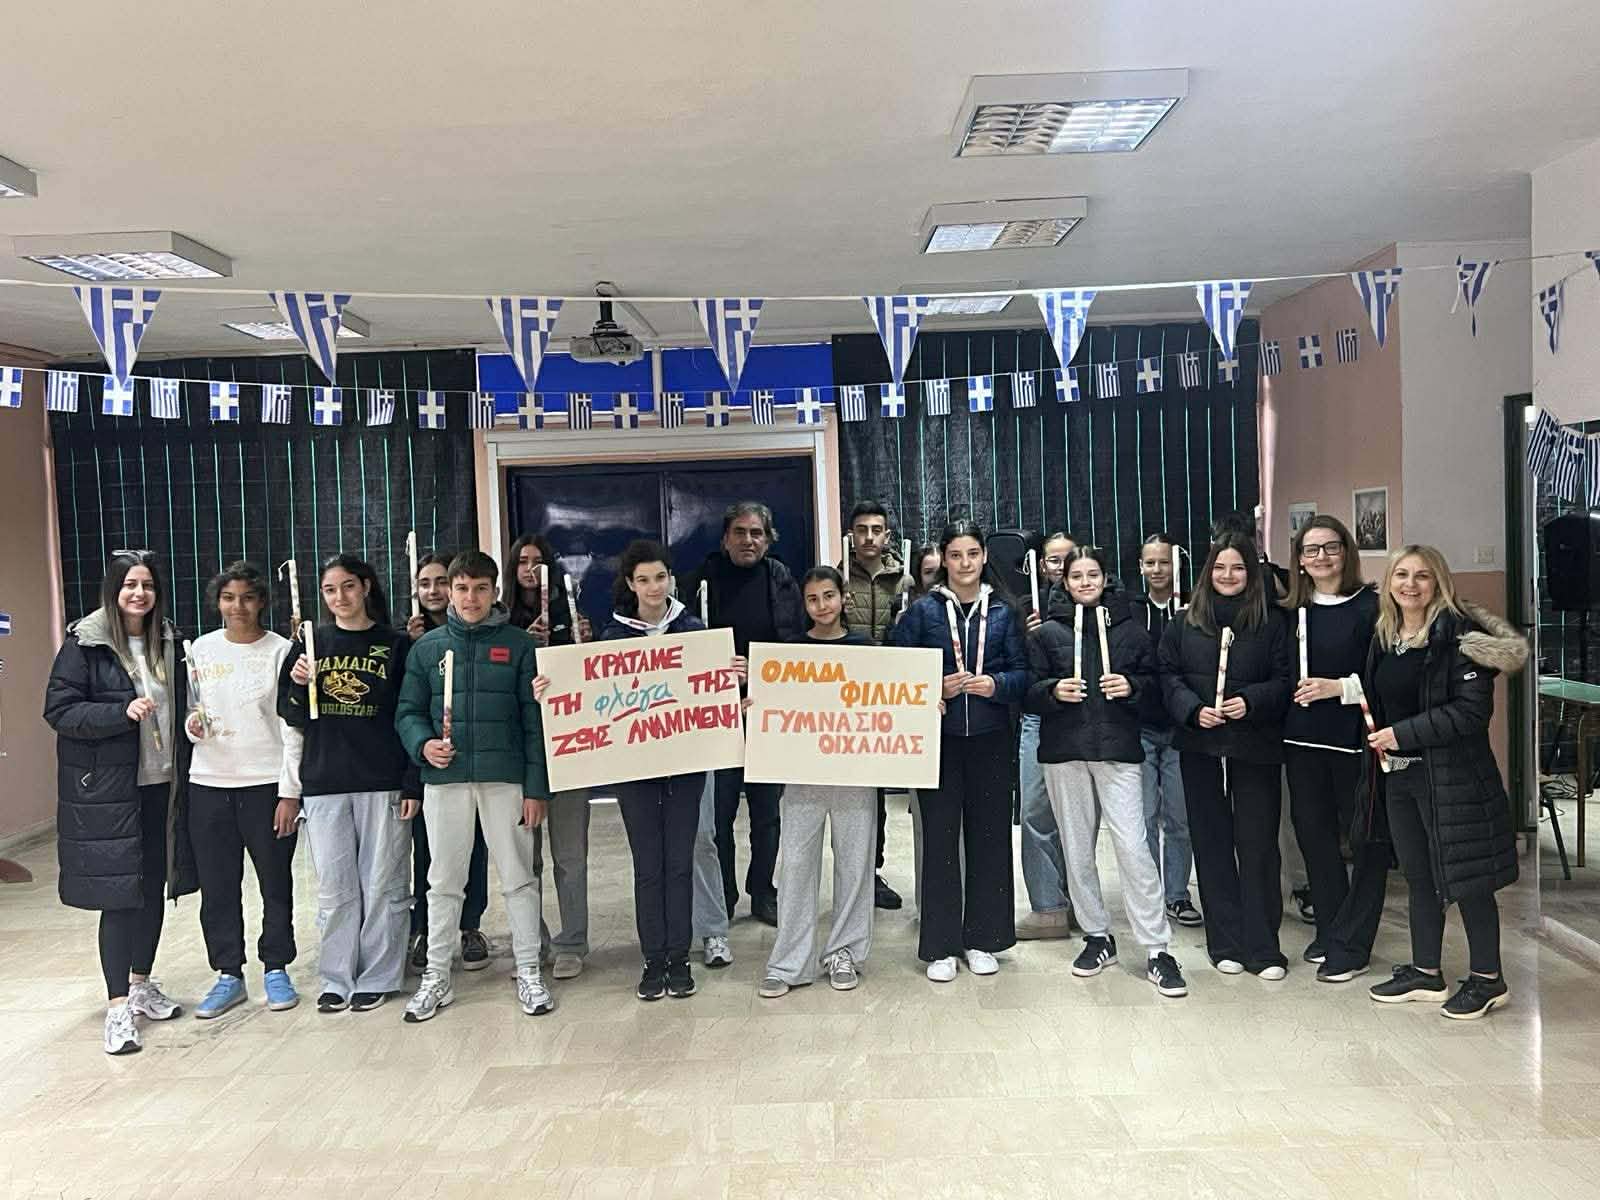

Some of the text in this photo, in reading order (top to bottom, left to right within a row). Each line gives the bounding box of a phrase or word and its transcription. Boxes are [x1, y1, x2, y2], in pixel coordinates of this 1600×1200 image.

[583, 645, 684, 681] ΚΡΑΤΑΜΕ
[761, 659, 847, 683] ΟΜΑΔΑ
[548, 669, 736, 718] ΤΗ φλόγα ΤΗΣ
[840, 680, 928, 708] ΦΙΛΙΑΣ
[551, 704, 739, 757] ΖΩΗΣ ΑΝΑΜΜΕΝΗ
[761, 709, 893, 733] ΓΥΜΝΑΣΙΟ
[818, 734, 924, 754] ΟΙΧΑΛΙΑΣ
